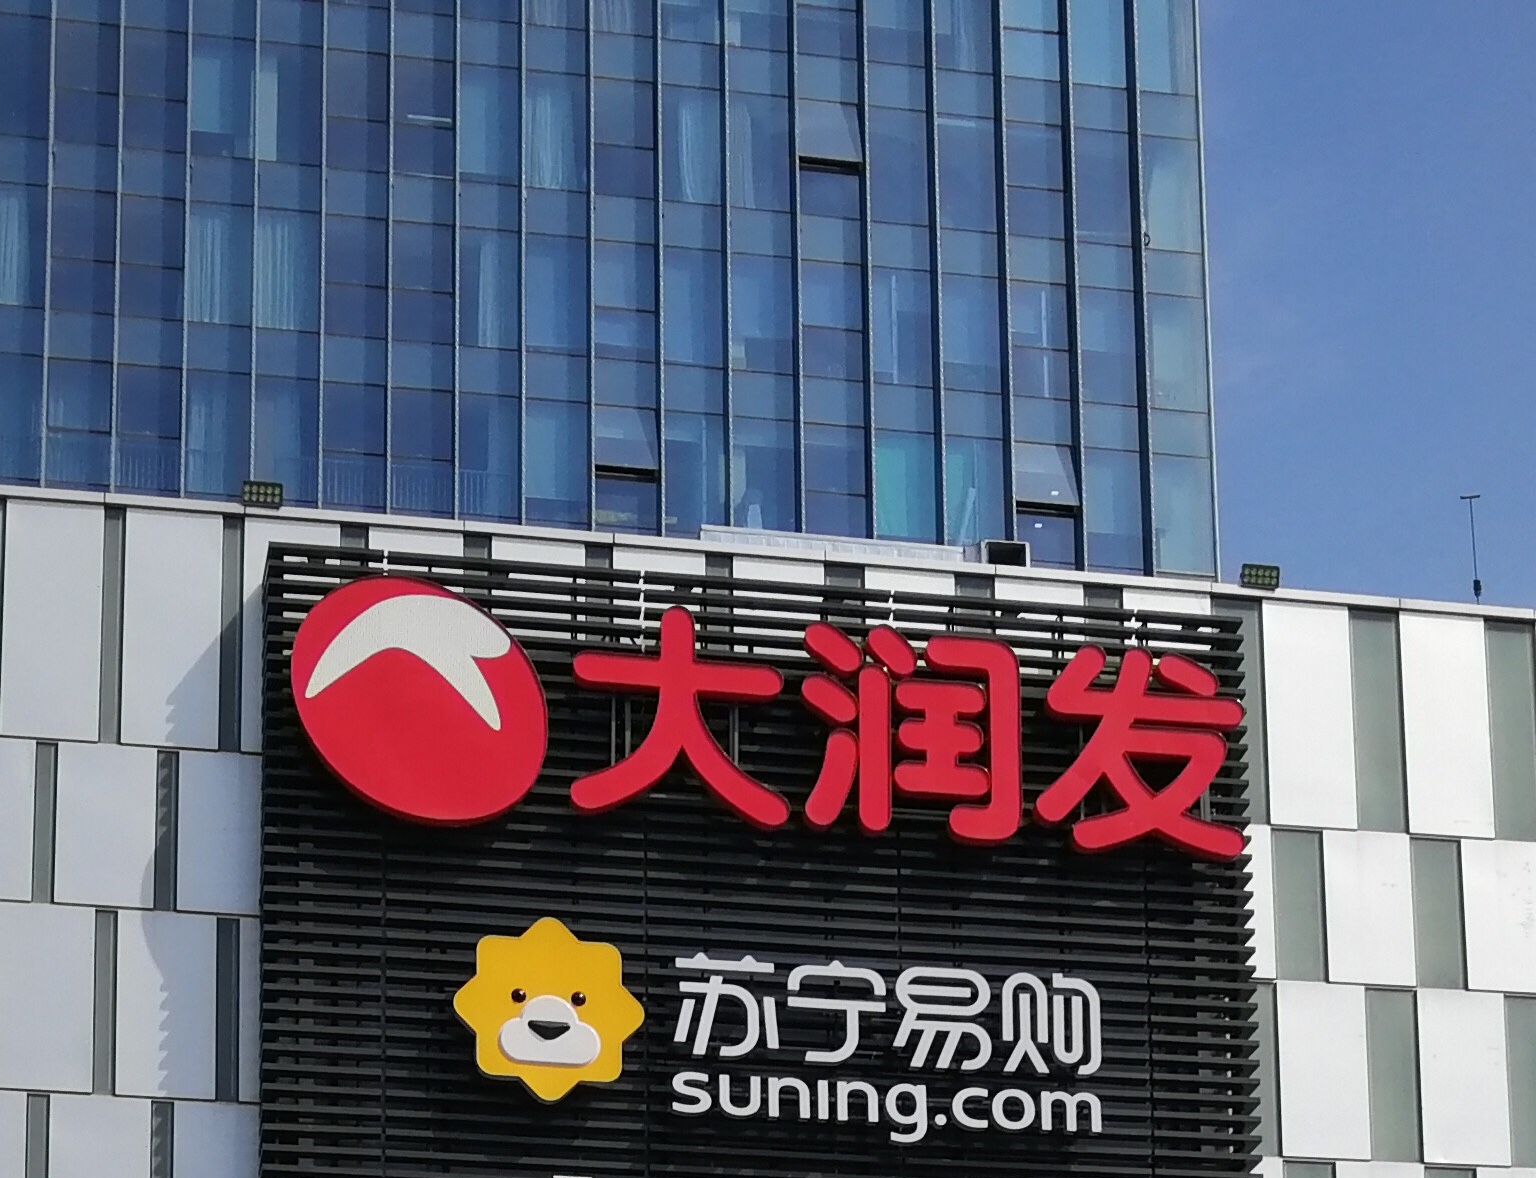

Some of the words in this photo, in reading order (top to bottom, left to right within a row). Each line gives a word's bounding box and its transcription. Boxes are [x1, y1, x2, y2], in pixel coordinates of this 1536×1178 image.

[569, 606, 1249, 863] 大润发
[673, 952, 1102, 1077] 苏宁易购
[671, 1070, 1103, 1144] suning.com
